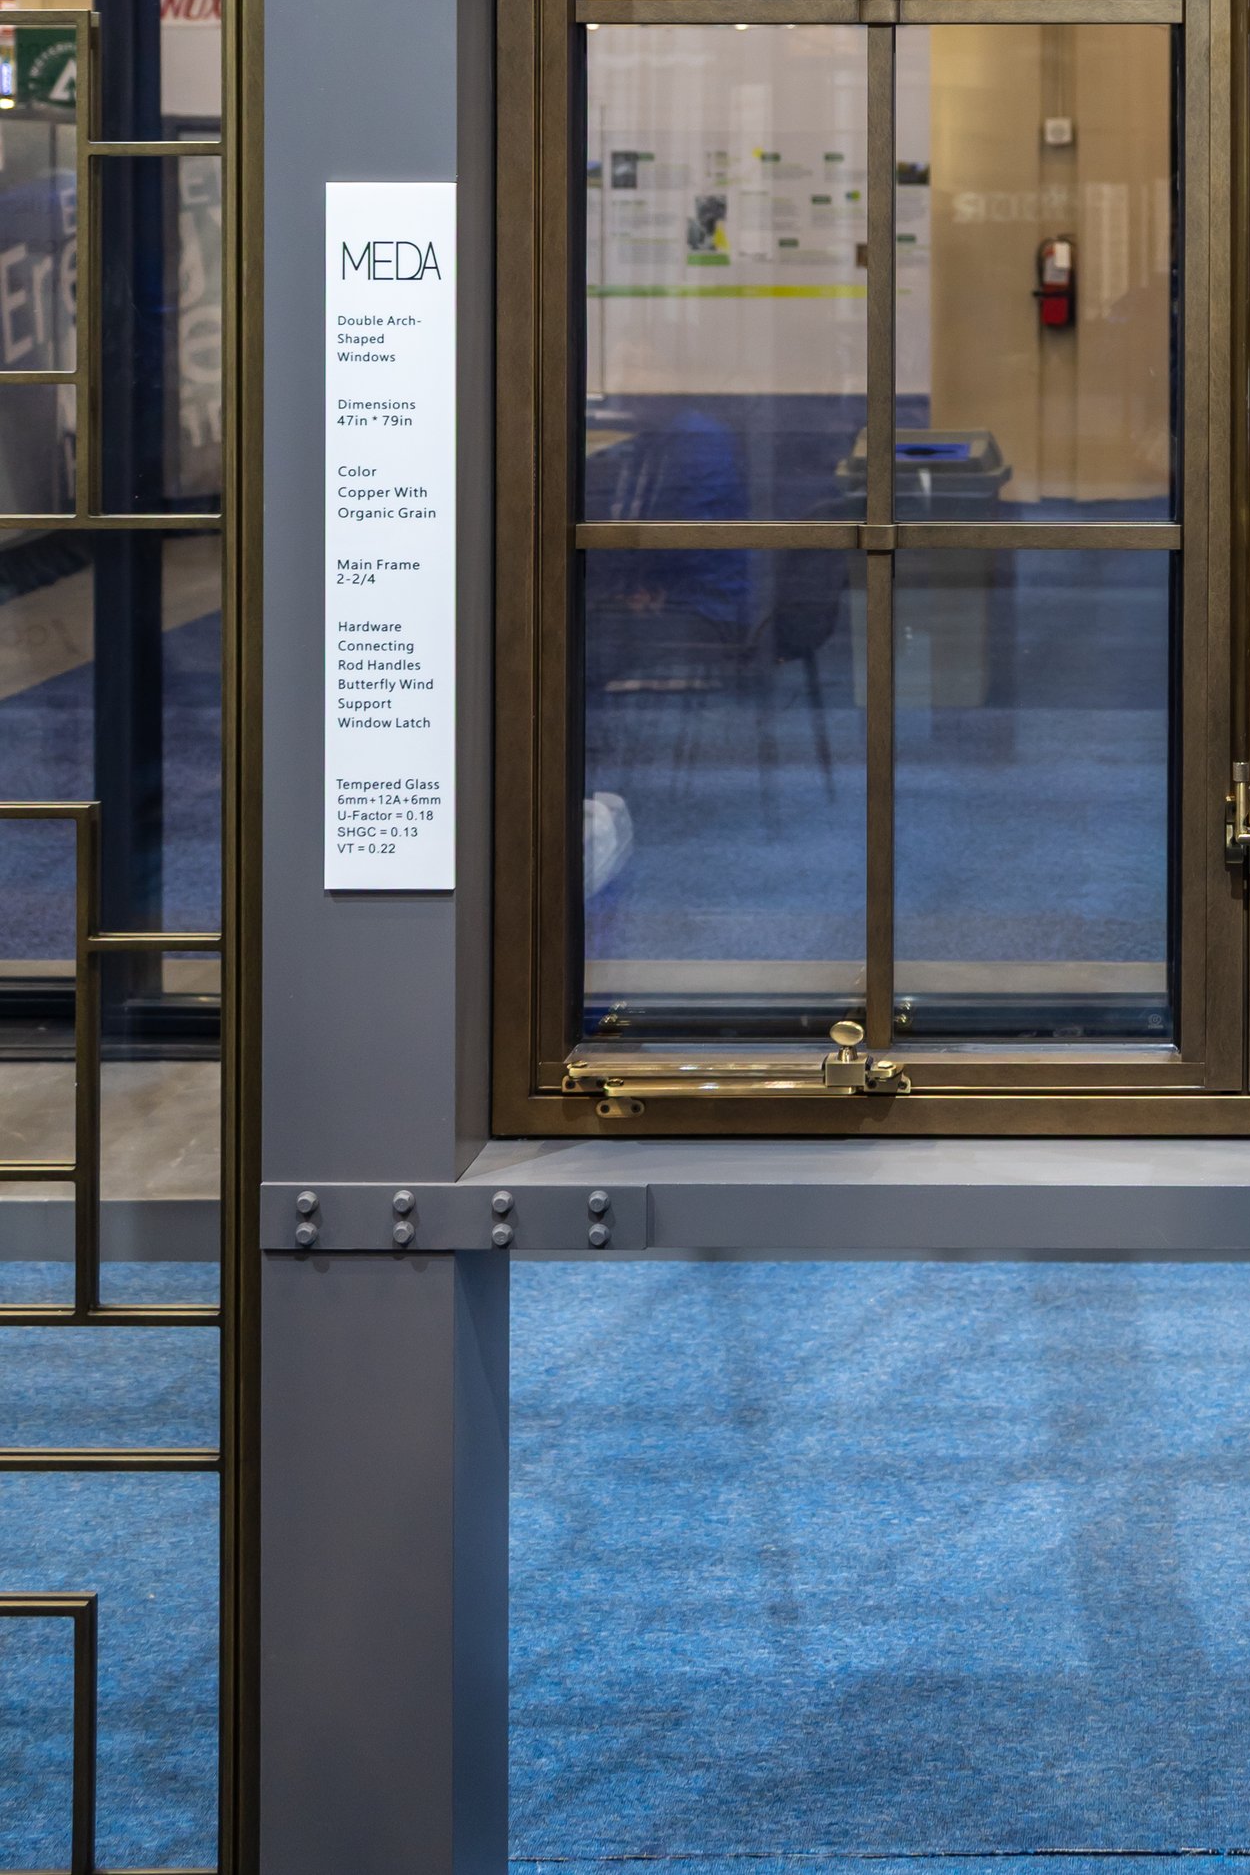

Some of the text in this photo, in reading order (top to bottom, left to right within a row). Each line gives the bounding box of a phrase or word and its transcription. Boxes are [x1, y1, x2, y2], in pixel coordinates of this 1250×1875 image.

[341, 240, 442, 281] MEDA
[337, 314, 422, 326] Double Arch-
[337, 333, 385, 347] Shaped
[336, 351, 396, 363] Windows
[337, 398, 416, 410] Dimensions
[336, 414, 368, 427] 47in
[381, 414, 413, 427] 79in
[337, 465, 377, 478] Color
[337, 486, 428, 501] Copper With
[337, 507, 437, 522] Organic Grain
[337, 558, 421, 571] Main Frame
[336, 573, 376, 586] 2-2/4
[338, 620, 402, 633] Hardware
[337, 639, 415, 655] Connecting
[338, 659, 421, 671] Rod Handles
[338, 677, 434, 693] Butterfly Wind
[337, 697, 392, 712] Support
[337, 716, 431, 729] Window Latch
[336, 778, 440, 793] Tempered Glass
[337, 809, 393, 821] U-Factor
[406, 809, 434, 821] 0.18
[337, 826, 377, 838] SHGC
[390, 826, 418, 838] 0.13
[336, 842, 354, 854] VT
[368, 842, 396, 854] 0.22
